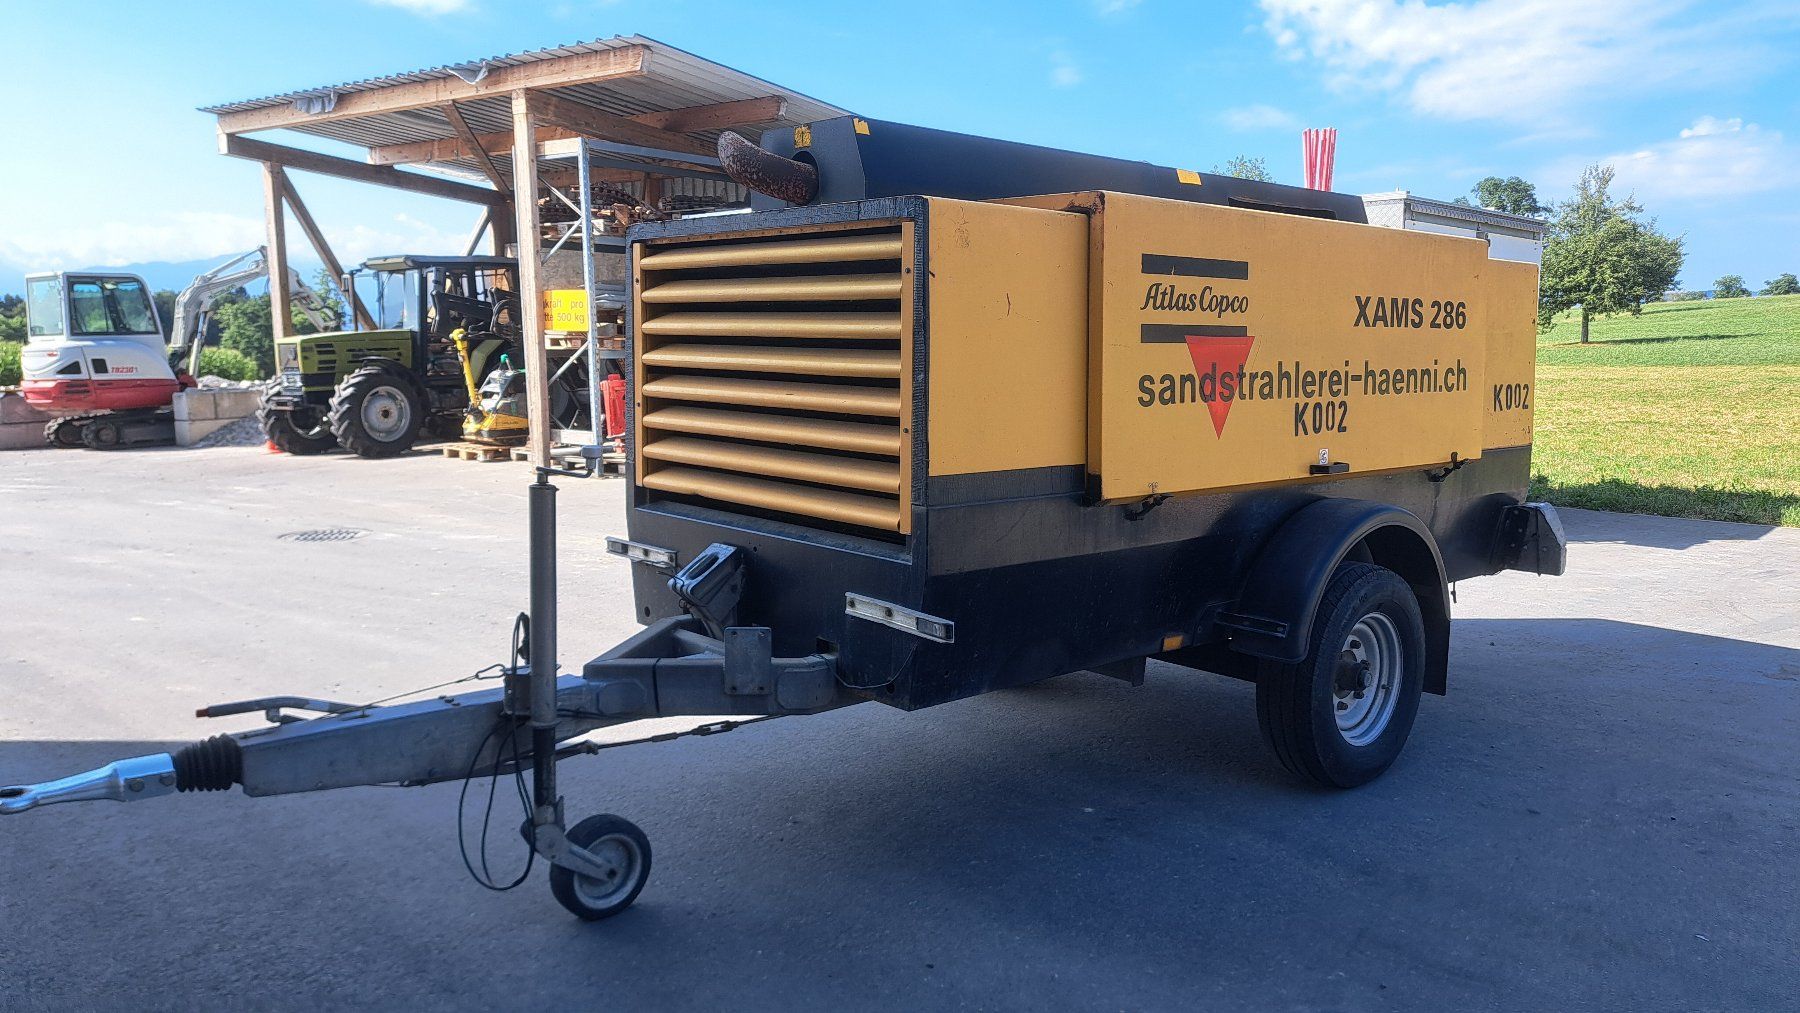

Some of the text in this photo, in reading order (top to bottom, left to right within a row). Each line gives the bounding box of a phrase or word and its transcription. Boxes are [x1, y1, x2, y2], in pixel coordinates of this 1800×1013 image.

[570, 301, 584, 311] pro
[1140, 282, 1249, 318] Atlas Copco
[1353, 295, 1467, 330] XAMS 286
[556, 312, 572, 322] 500
[574, 312, 585, 325] kg
[1137, 359, 1467, 408] sandstrahlerei-haenni.ch
[1493, 383, 1530, 412] K002
[1294, 400, 1348, 437] K002
